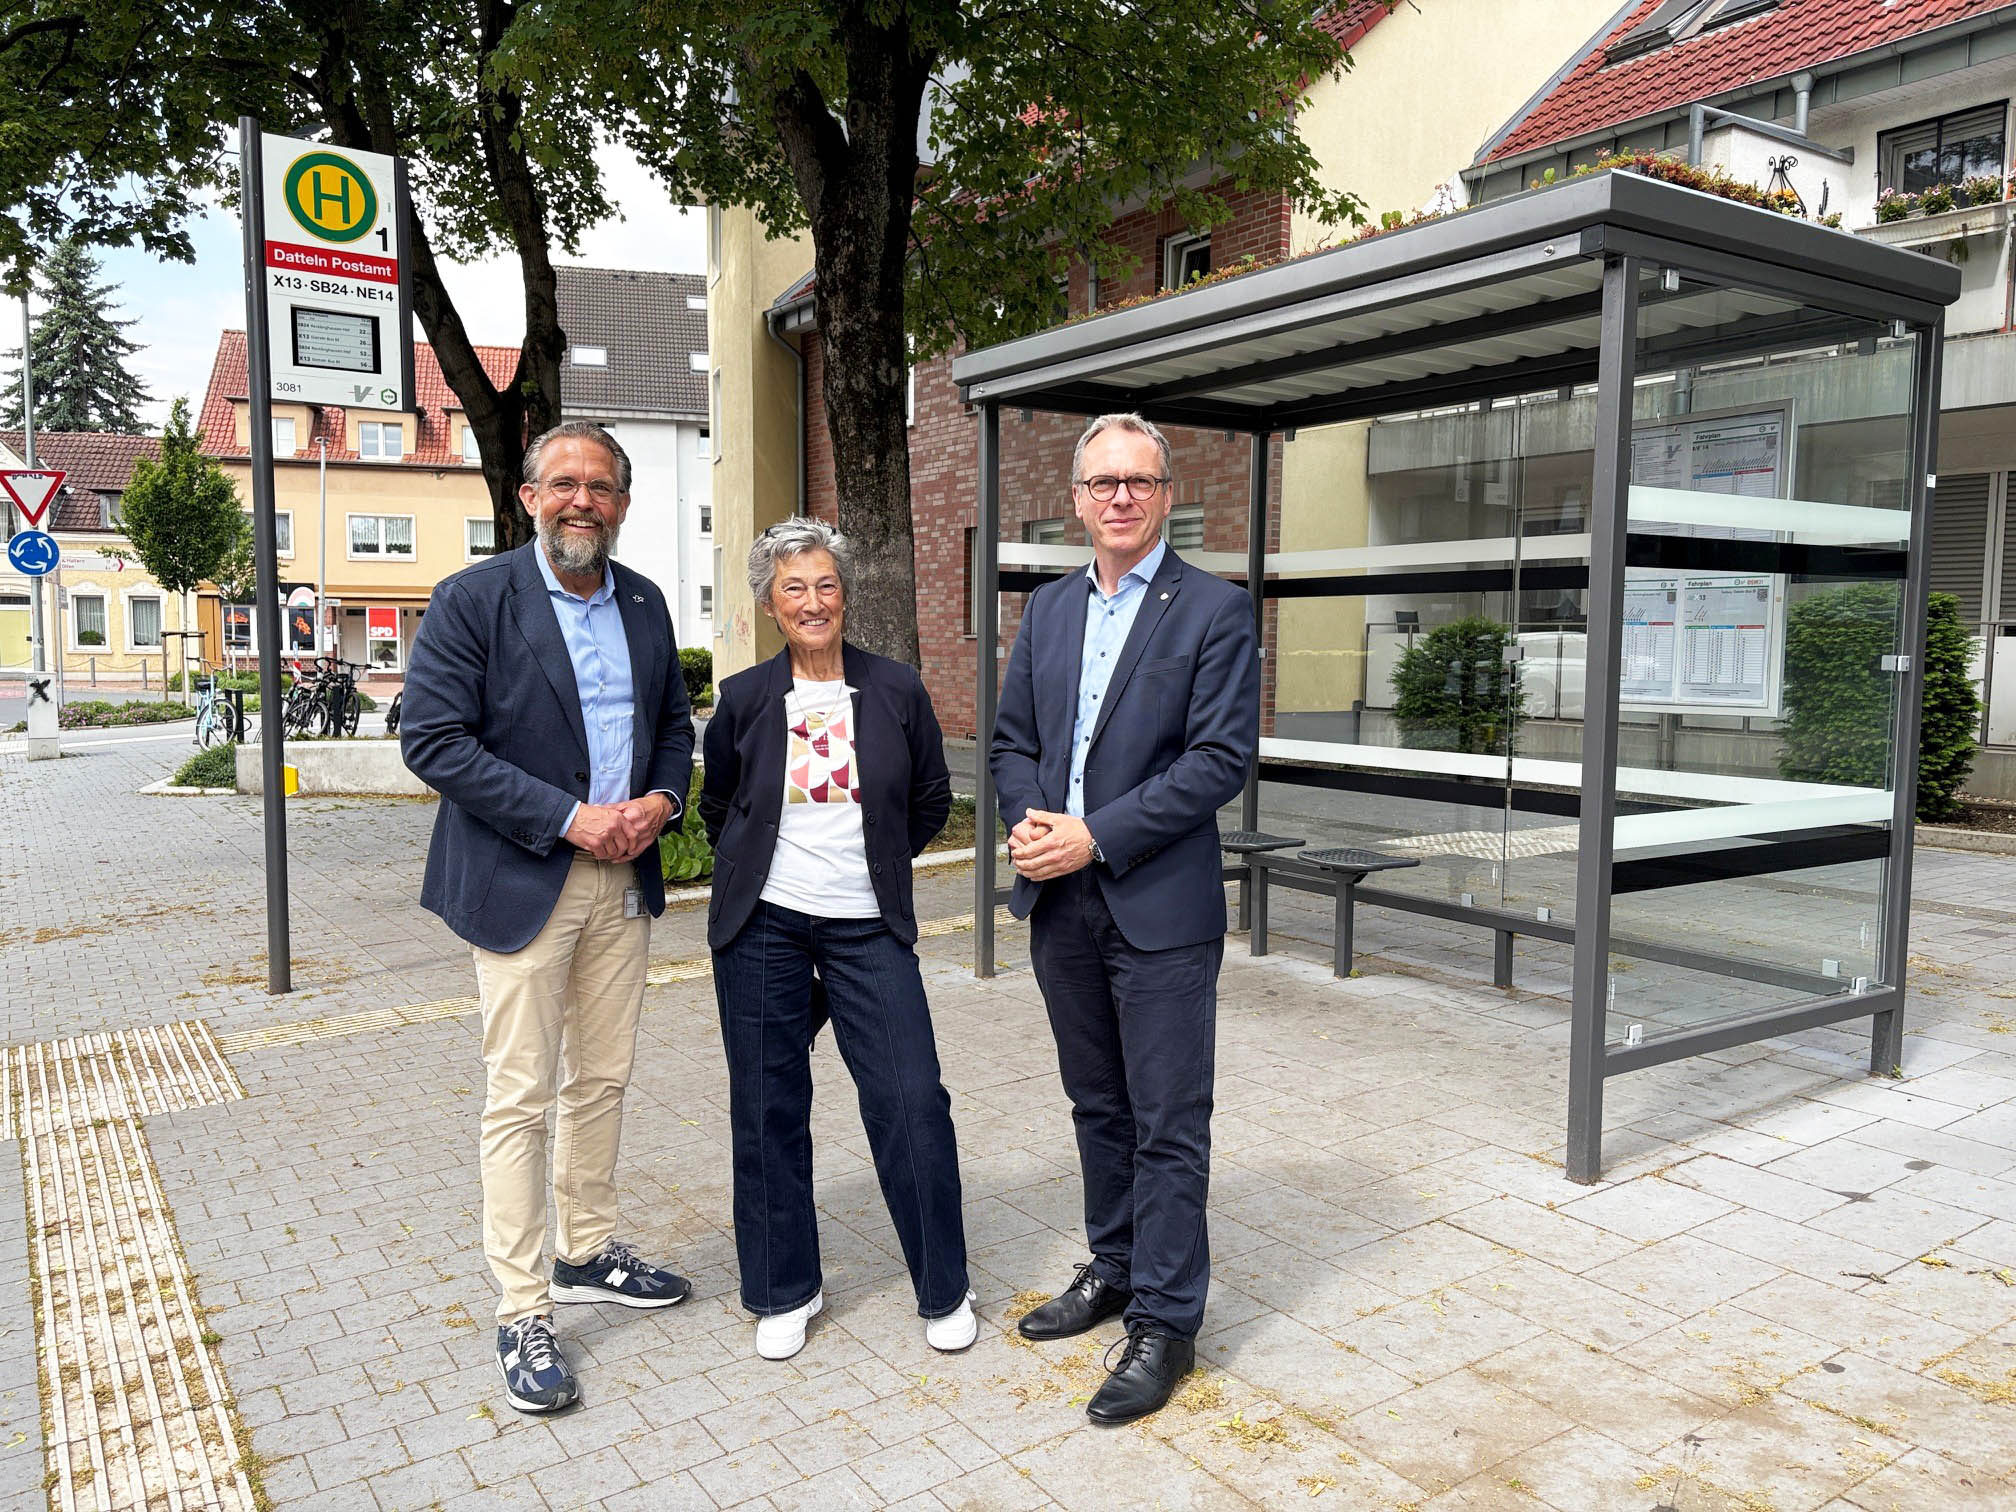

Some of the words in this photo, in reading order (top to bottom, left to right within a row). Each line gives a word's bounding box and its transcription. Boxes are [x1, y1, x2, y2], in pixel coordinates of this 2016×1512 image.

[312, 171, 350, 224] H
[376, 227, 389, 252] 1
[274, 249, 327, 268] Datteln
[332, 257, 392, 277] Postamt
[276, 382, 302, 393] 3081
[370, 626, 394, 637] SPD
